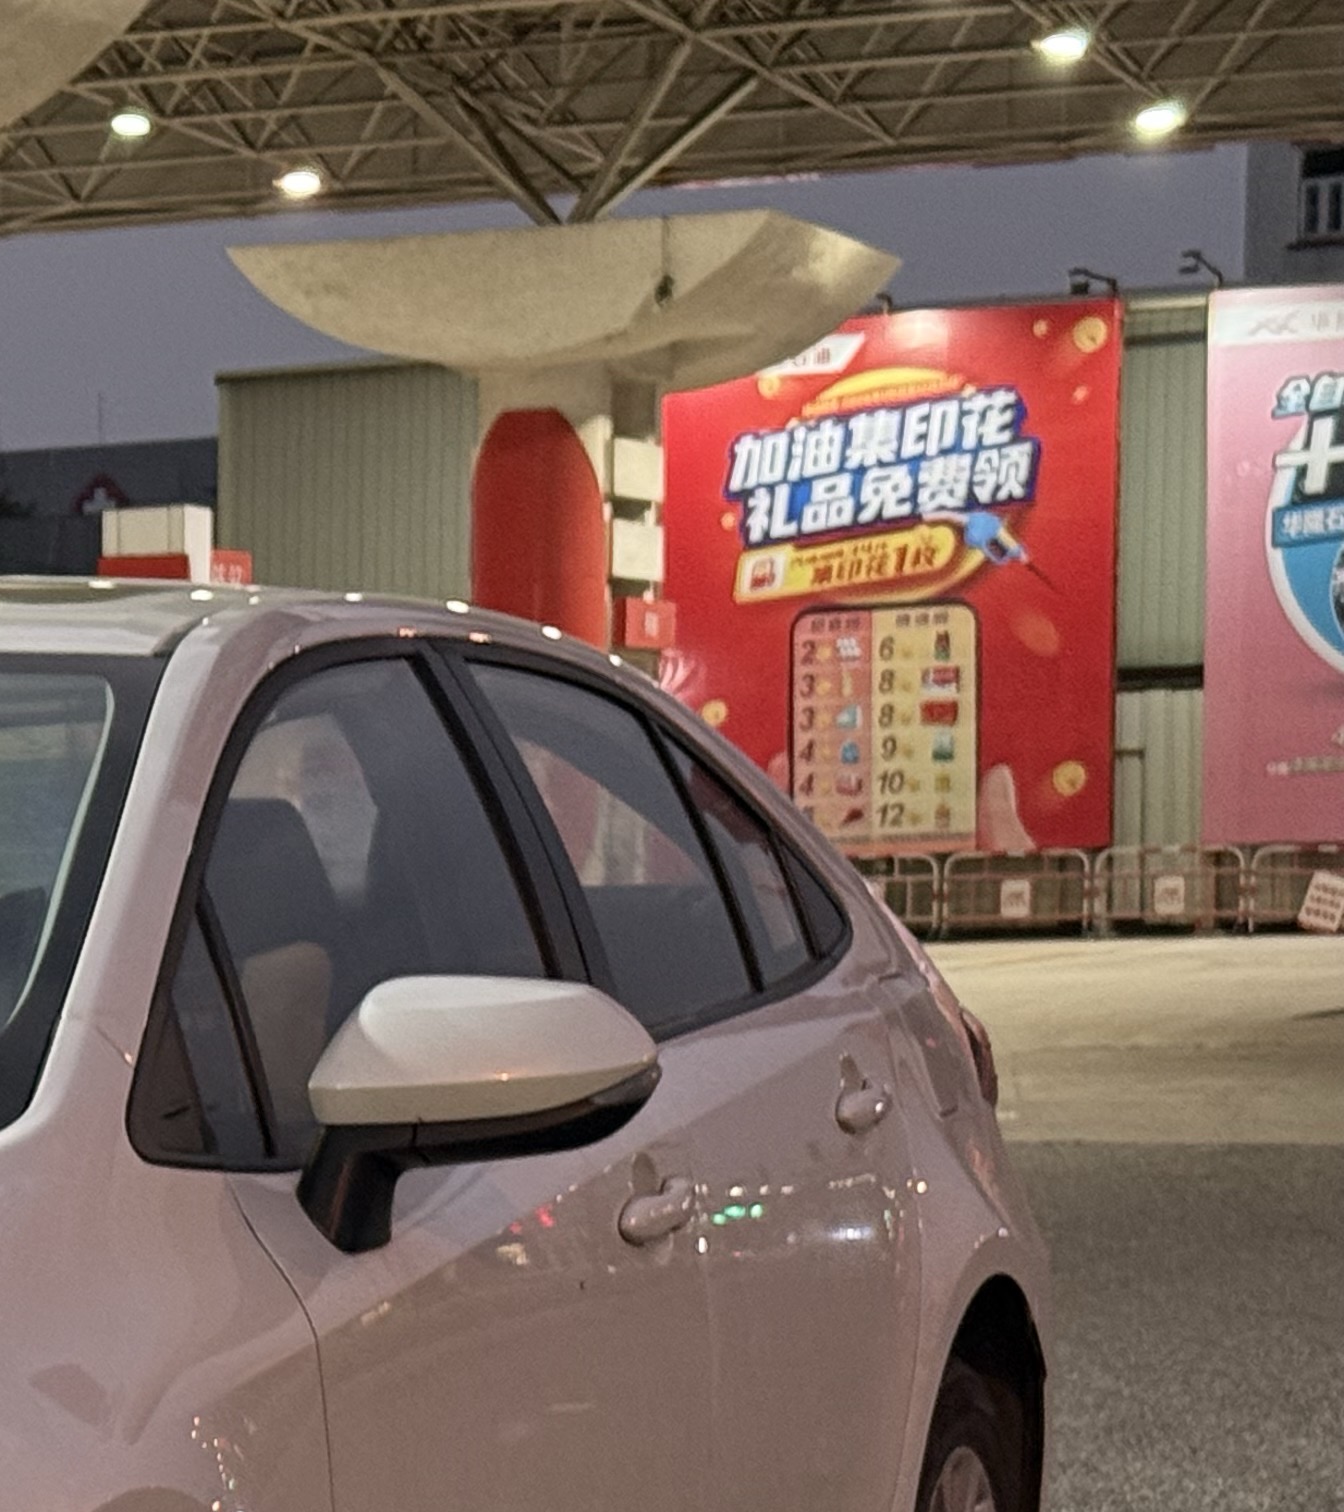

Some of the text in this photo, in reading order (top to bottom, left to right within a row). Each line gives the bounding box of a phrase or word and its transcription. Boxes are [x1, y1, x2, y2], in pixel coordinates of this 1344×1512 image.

[730, 390, 1018, 492] 加油集印花
[746, 441, 1034, 543] 礼品免费领
[879, 636, 895, 661] 6
[878, 669, 895, 694] 8
[878, 703, 895, 728] 8
[881, 735, 897, 760] 9
[878, 770, 905, 794] 10
[877, 803, 905, 827] 12
